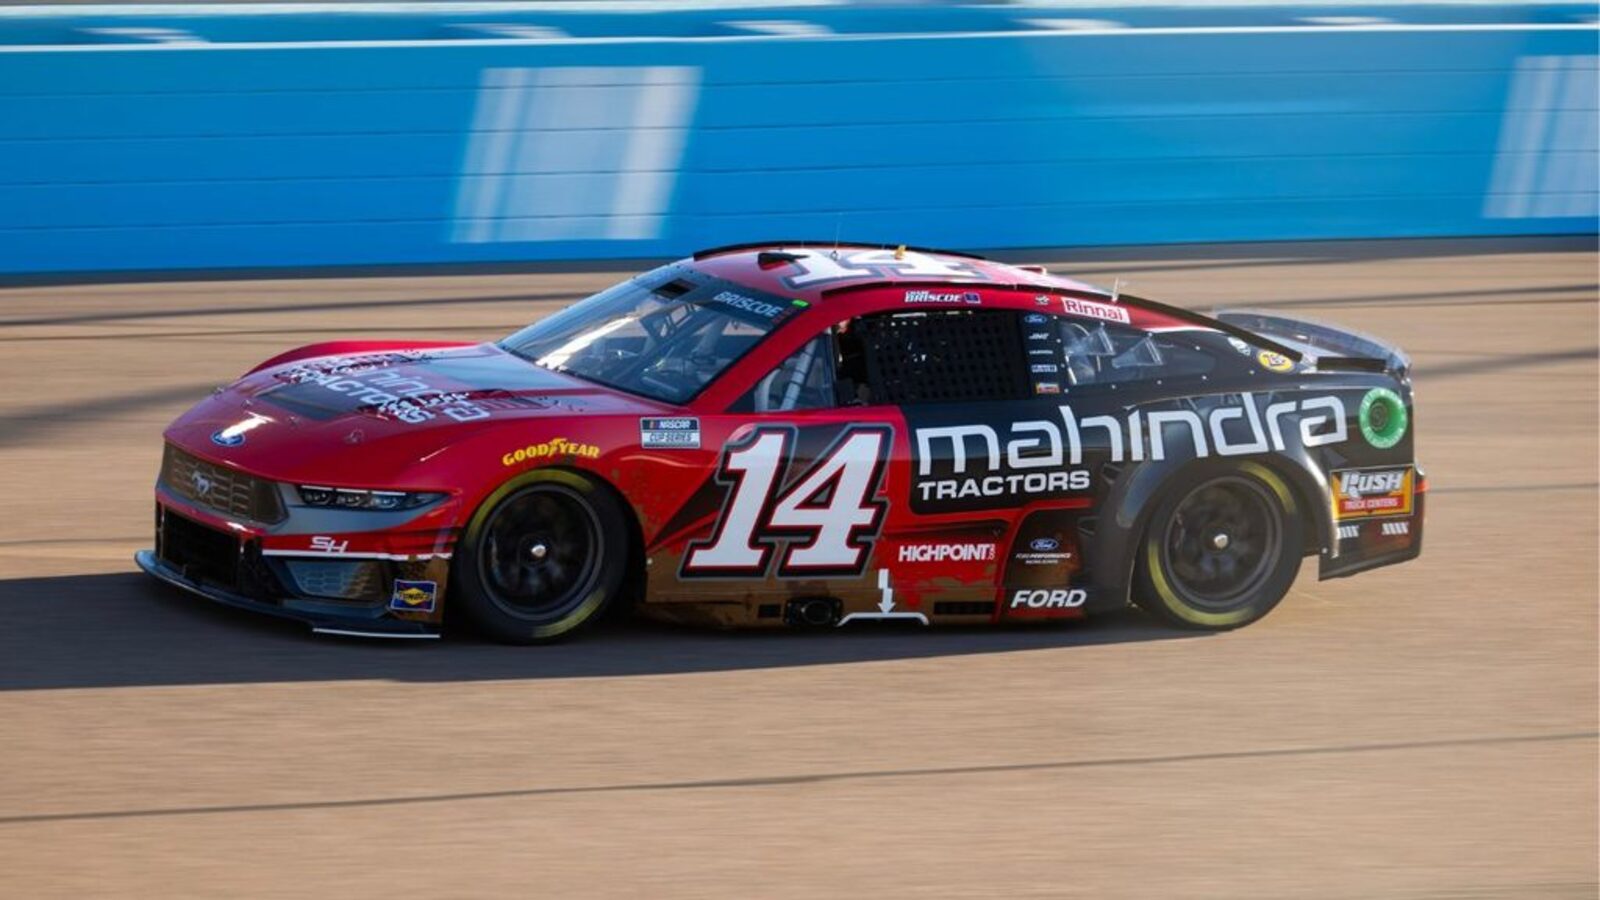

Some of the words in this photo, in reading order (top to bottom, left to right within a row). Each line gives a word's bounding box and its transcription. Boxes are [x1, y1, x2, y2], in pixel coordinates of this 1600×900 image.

[788, 249, 987, 287] 14
[713, 291, 783, 317] BRISCOE
[1065, 300, 1123, 320] Rinnai
[659, 419, 691, 429] NASCAR
[916, 391, 1349, 476] mahindra
[502, 438, 600, 466] GOODYEAR
[918, 470, 1090, 501] TRACTORS
[685, 428, 886, 573] 14
[899, 544, 989, 562] HIGHPOINT
[1033, 539, 1056, 549] Ford
[1011, 589, 1087, 608] FORD
